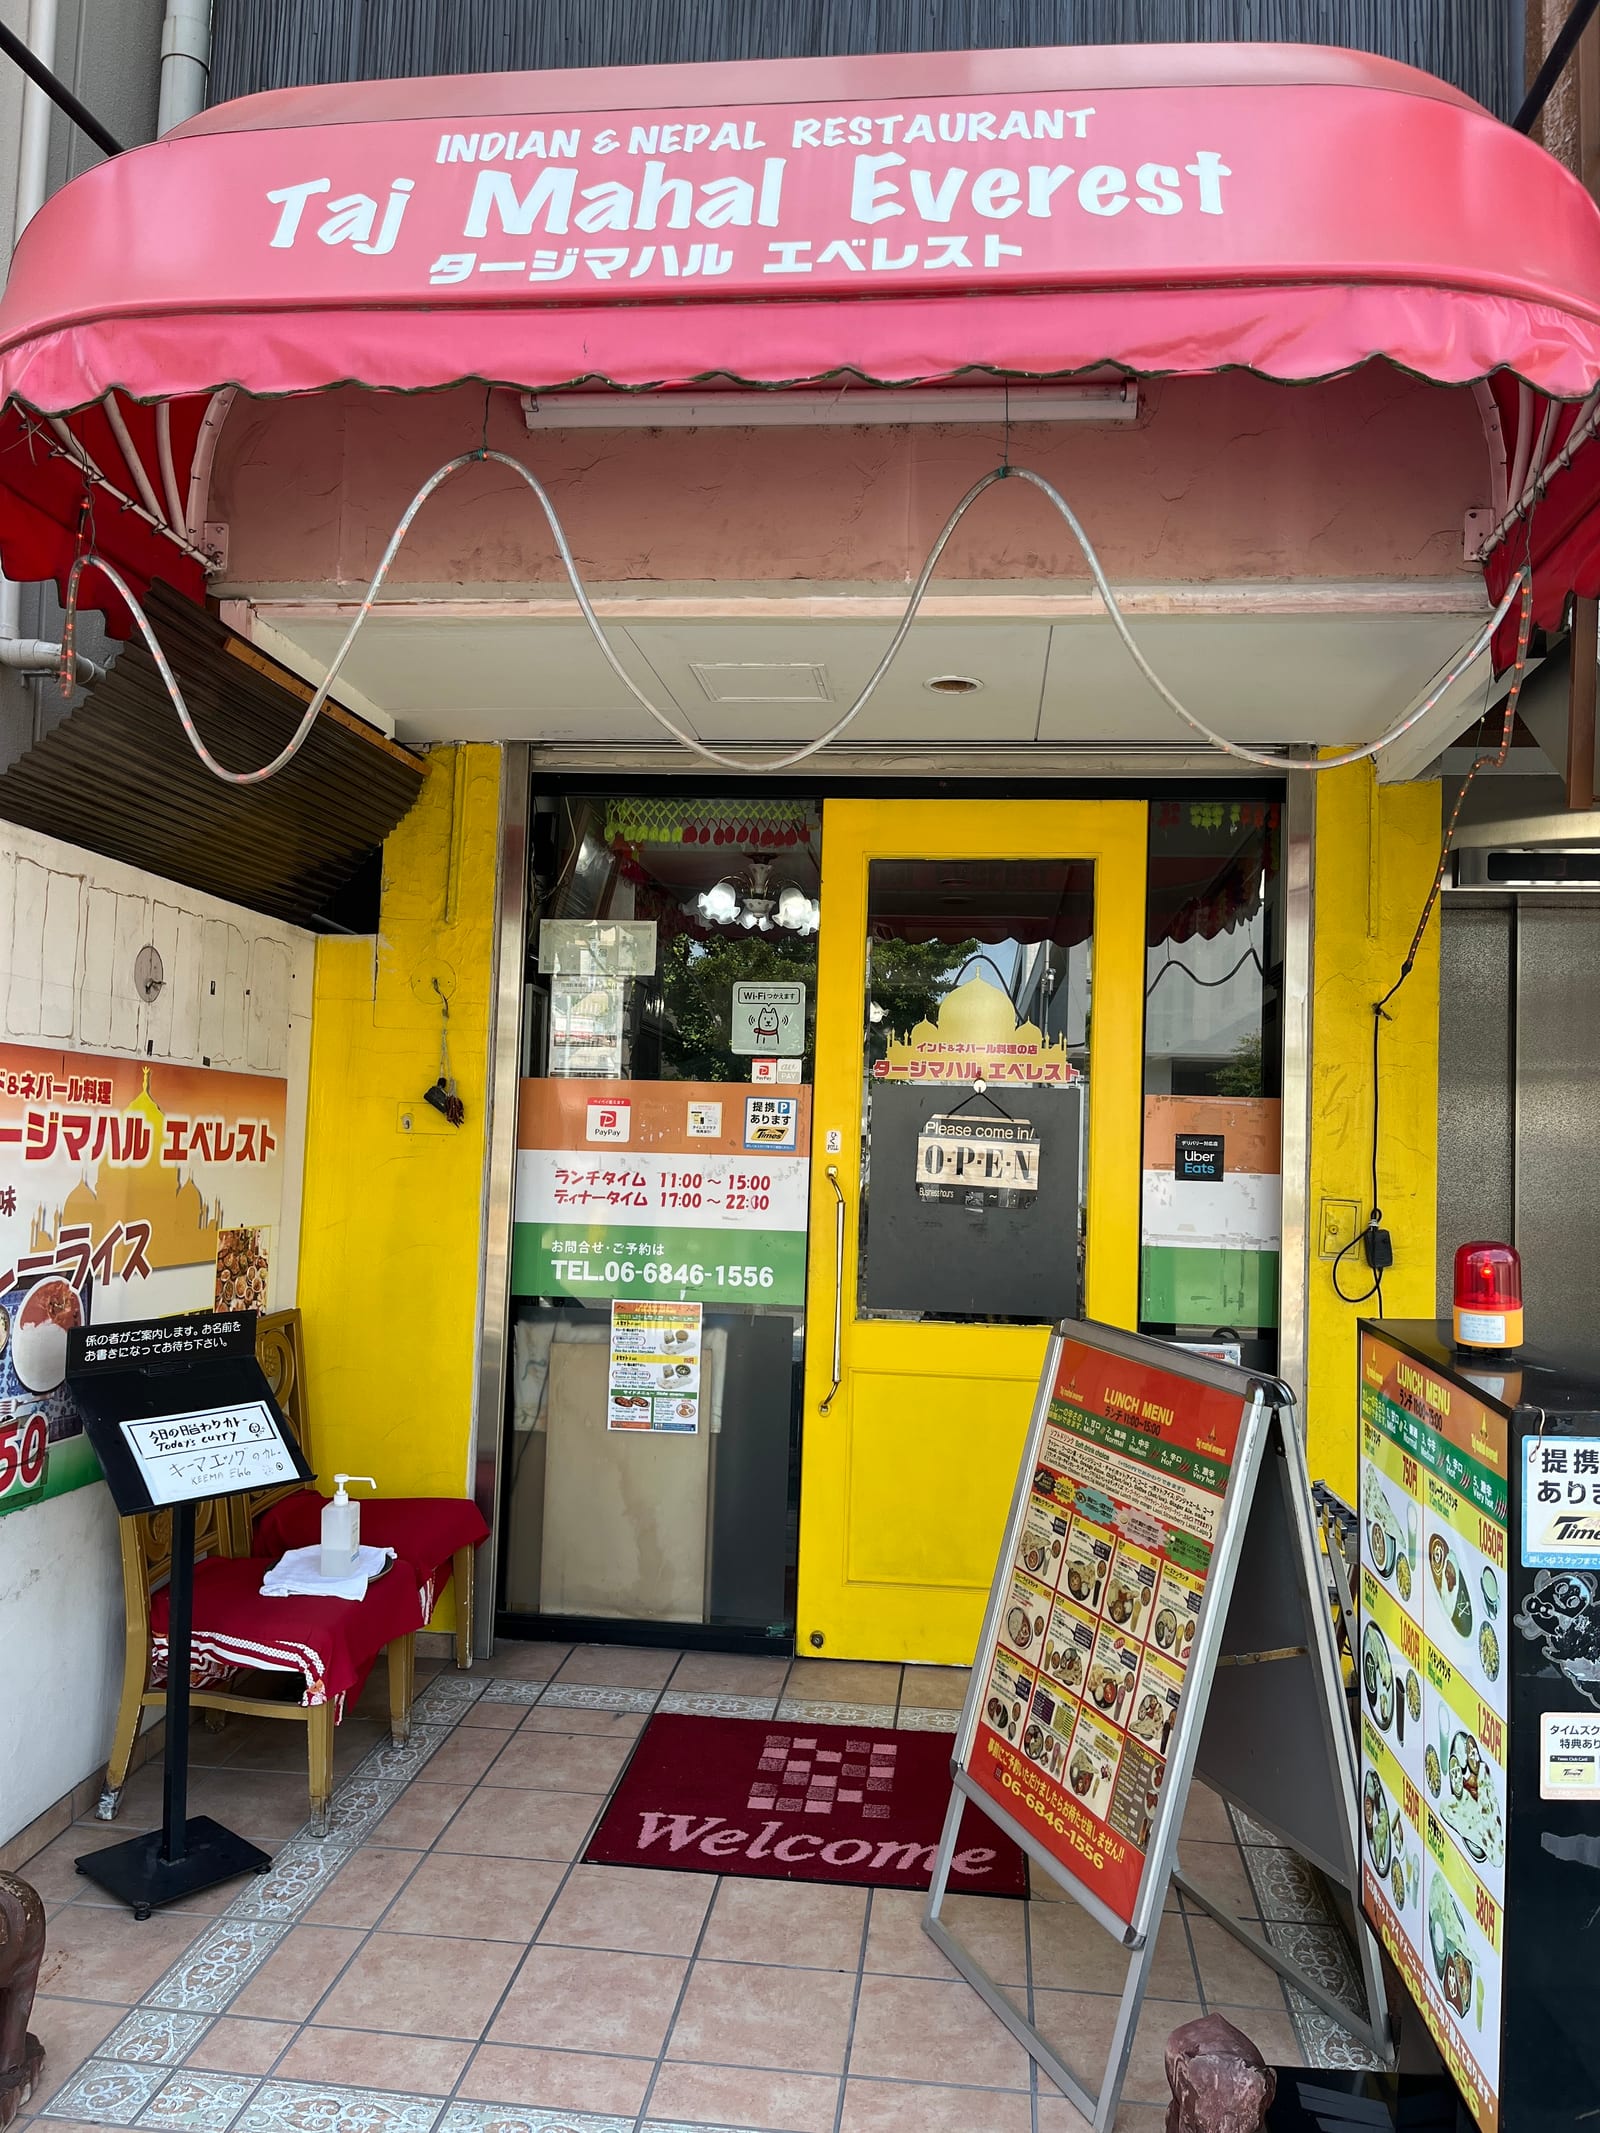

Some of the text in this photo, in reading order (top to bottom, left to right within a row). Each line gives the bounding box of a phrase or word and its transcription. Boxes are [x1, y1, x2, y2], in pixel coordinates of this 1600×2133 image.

[436, 108, 1095, 163] INDIAN & NEPAL RESTAURANT
[266, 151, 1232, 255] Taj Mahal Everest
[429, 234, 1023, 284] タージマハル エベレスト
[873, 1060, 1080, 1081] タージマハル エベレスト
[752, 1102, 775, 1113] 提携
[750, 1114, 791, 1126] あります
[595, 1129, 621, 1137] PayPay
[757, 1129, 786, 1141] Times
[925, 1122, 971, 1137] Please
[976, 1128, 1013, 1139] come
[163, 1120, 275, 1163] エベレスト
[1184, 1150, 1215, 1162] Uber
[1184, 1162, 1215, 1174] Eats
[555, 1170, 646, 1187] ランチタイム
[660, 1173, 702, 1189] 11:00
[728, 1175, 770, 1190] 15:00
[554, 1190, 648, 1206] ディナータイム
[660, 1192, 702, 1208] 17:00
[1397, 1361, 1424, 1398] LUNCH
[1426, 1379, 1450, 1416] MENU
[1104, 1388, 1140, 1414] LUNCH
[1141, 1401, 1174, 1426] MENU
[1104, 1406, 1122, 1421] ランチ
[201, 1431, 236, 1444] curry
[1105, 1434, 1125, 1447] Normal
[1160, 1457, 1172, 1467] Hot
[1541, 1448, 1600, 1474] 提携
[1192, 1471, 1216, 1486] Very hot
[1446, 1466, 1456, 1480] Hot
[1473, 1487, 1484, 1504] Very
[1479, 1517, 1504, 1569] 1,050円
[1478, 1702, 1502, 1767] 1,250円
[1001, 1773, 1104, 1870] 06-6846-1556
[636, 1811, 997, 1876] Welcome
[1475, 1884, 1495, 1945] 580円
